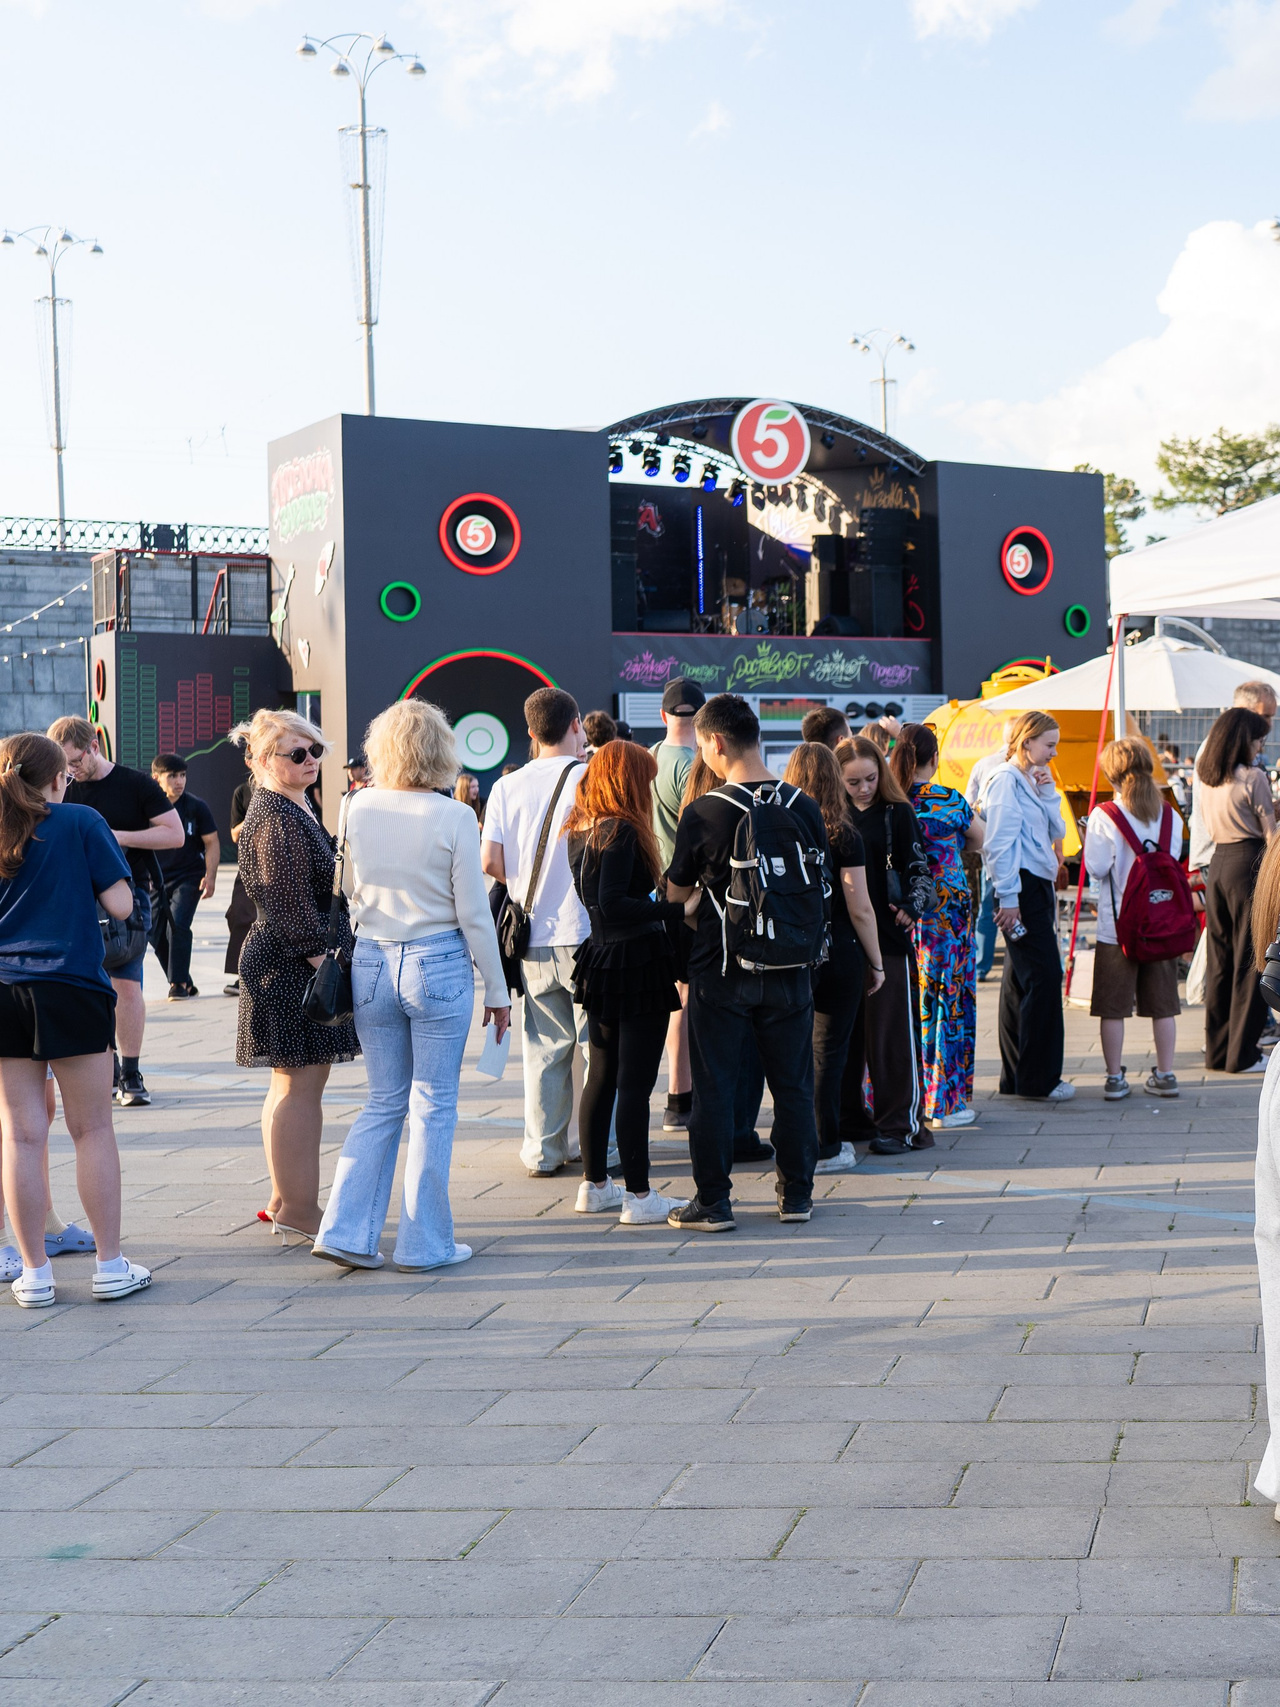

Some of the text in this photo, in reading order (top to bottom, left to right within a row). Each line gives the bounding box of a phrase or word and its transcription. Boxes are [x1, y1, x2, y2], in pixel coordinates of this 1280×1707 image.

[751, 405, 795, 470] 5
[466, 519, 488, 549] 5
[949, 721, 1002, 749] КВАС
